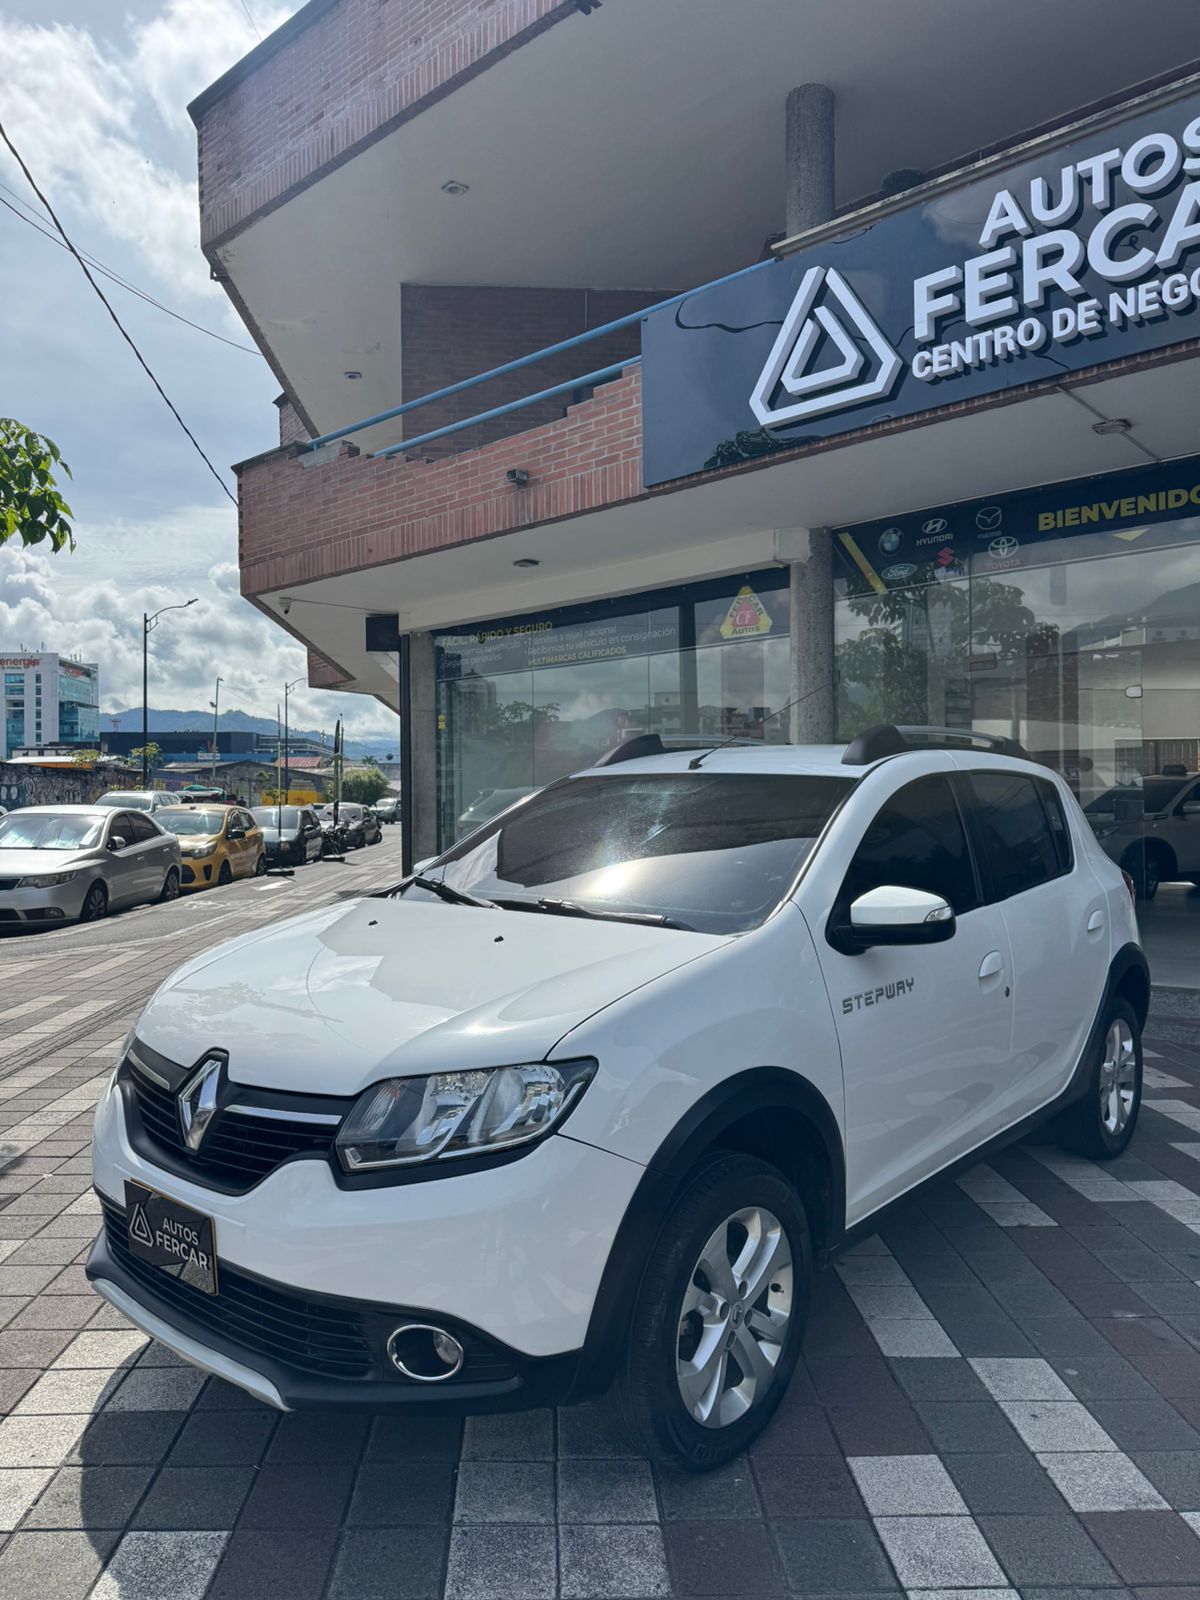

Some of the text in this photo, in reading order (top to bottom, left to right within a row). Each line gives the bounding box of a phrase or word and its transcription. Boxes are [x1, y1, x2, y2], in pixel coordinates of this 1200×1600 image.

[912, 317, 1046, 380] CENTRO
[1052, 299, 1103, 343] DE
[916, 533, 954, 547] HYUNDAI
[985, 559, 1022, 571] TOYOTA
[513, 621, 552, 635] SEGURO
[584, 625, 617, 638] nacional
[608, 636, 619, 645] en
[620, 626, 676, 642] consignación
[528, 646, 626, 667] MULTIMARCAS CALIFICADOS
[842, 977, 915, 1015] STEPWAY
[162, 1217, 199, 1246] AUTOS
[155, 1230, 209, 1271] FERCAR
